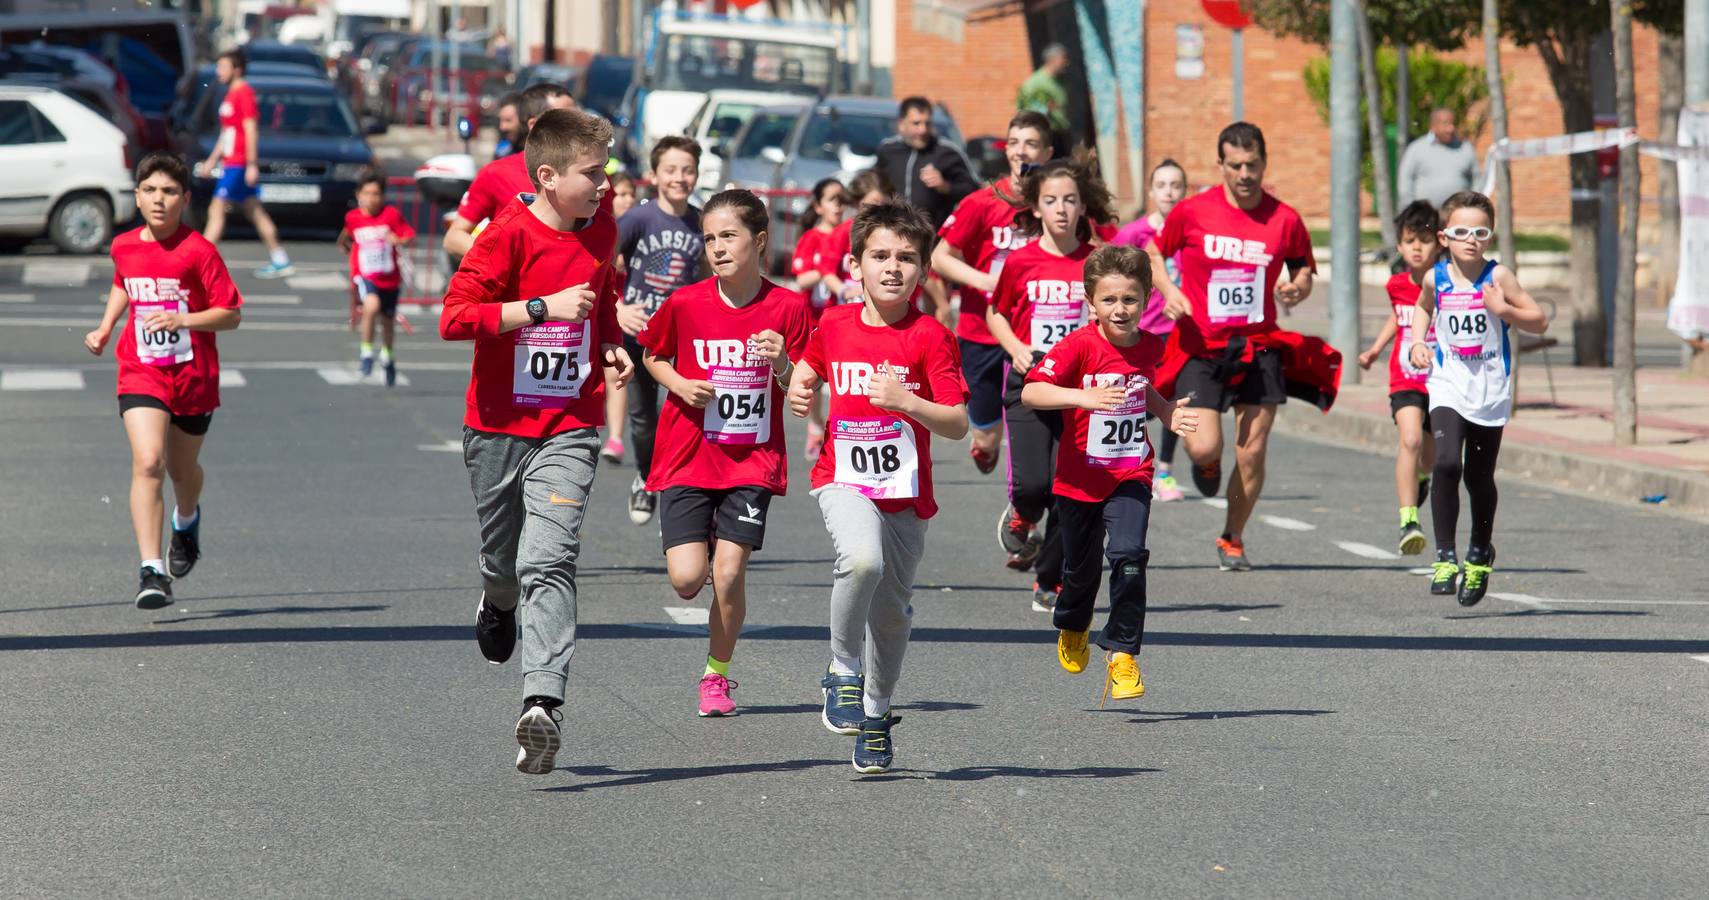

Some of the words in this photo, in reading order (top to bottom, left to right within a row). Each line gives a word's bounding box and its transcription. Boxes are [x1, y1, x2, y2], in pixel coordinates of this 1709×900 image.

[637, 229, 702, 262] VARSIT
[1203, 234, 1243, 262] UR
[123, 277, 159, 302] UR
[1026, 280, 1070, 304] UR
[1219, 286, 1254, 305] 063
[1448, 314, 1487, 335] 048
[531, 351, 579, 381] 075
[692, 338, 745, 370] UR
[831, 362, 875, 396] UR
[877, 364, 910, 375] CARERA
[718, 393, 766, 420] 054
[1101, 417, 1146, 445] 205
[851, 444, 901, 475] 018
